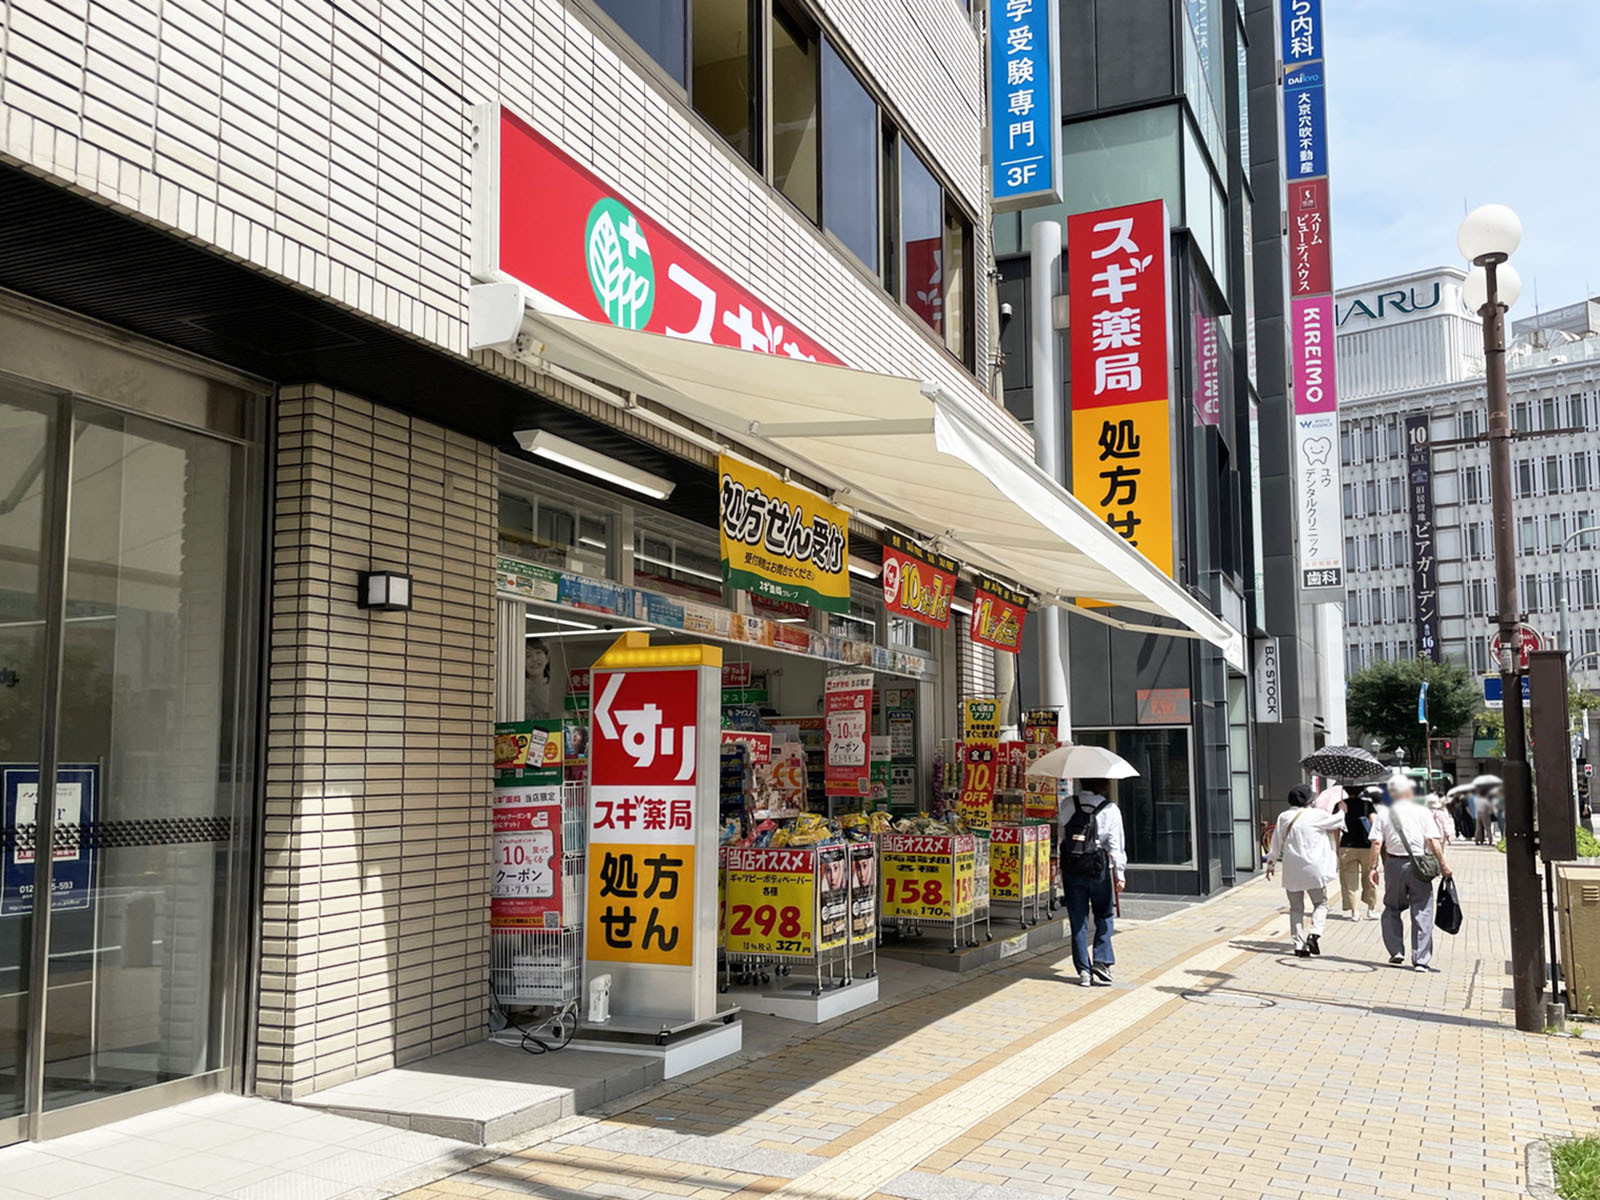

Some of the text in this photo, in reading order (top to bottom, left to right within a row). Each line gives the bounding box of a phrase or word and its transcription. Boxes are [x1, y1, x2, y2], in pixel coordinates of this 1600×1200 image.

[1006, 0, 1035, 150] 学受験専門
[1298, 92, 1314, 174] 大京穴吹不動産
[1007, 164, 1037, 187] 3F
[1310, 212, 1323, 246] スリム
[1296, 214, 1311, 292] ビューティハウス
[665, 263, 820, 362] スギ
[1091, 217, 1154, 396] スギ薬局
[1335, 282, 1441, 328] ARU
[1303, 307, 1324, 403] KIREIMO
[1408, 426, 1427, 445] 10
[1320, 468, 1332, 488] ユウ
[1305, 467, 1319, 557] デンタルクリニック
[1306, 571, 1338, 587] 歯科
[1414, 521, 1435, 622] ビアガーデン
[1421, 635, 1434, 649] 16
[1265, 646, 1277, 714] B.C STOCK
[593, 672, 696, 781] くすり
[525, 791, 556, 803] 当店限定
[593, 795, 692, 831] スギ薬局
[963, 791, 988, 802] OFF
[728, 850, 815, 872] 当店オススメ!
[881, 833, 952, 853] 当店オススメ!
[496, 869, 542, 883] クーポン
[600, 851, 684, 900] 処方
[763, 886, 778, 897] 各種
[600, 906, 679, 951] せん
[775, 940, 812, 954] 327円
